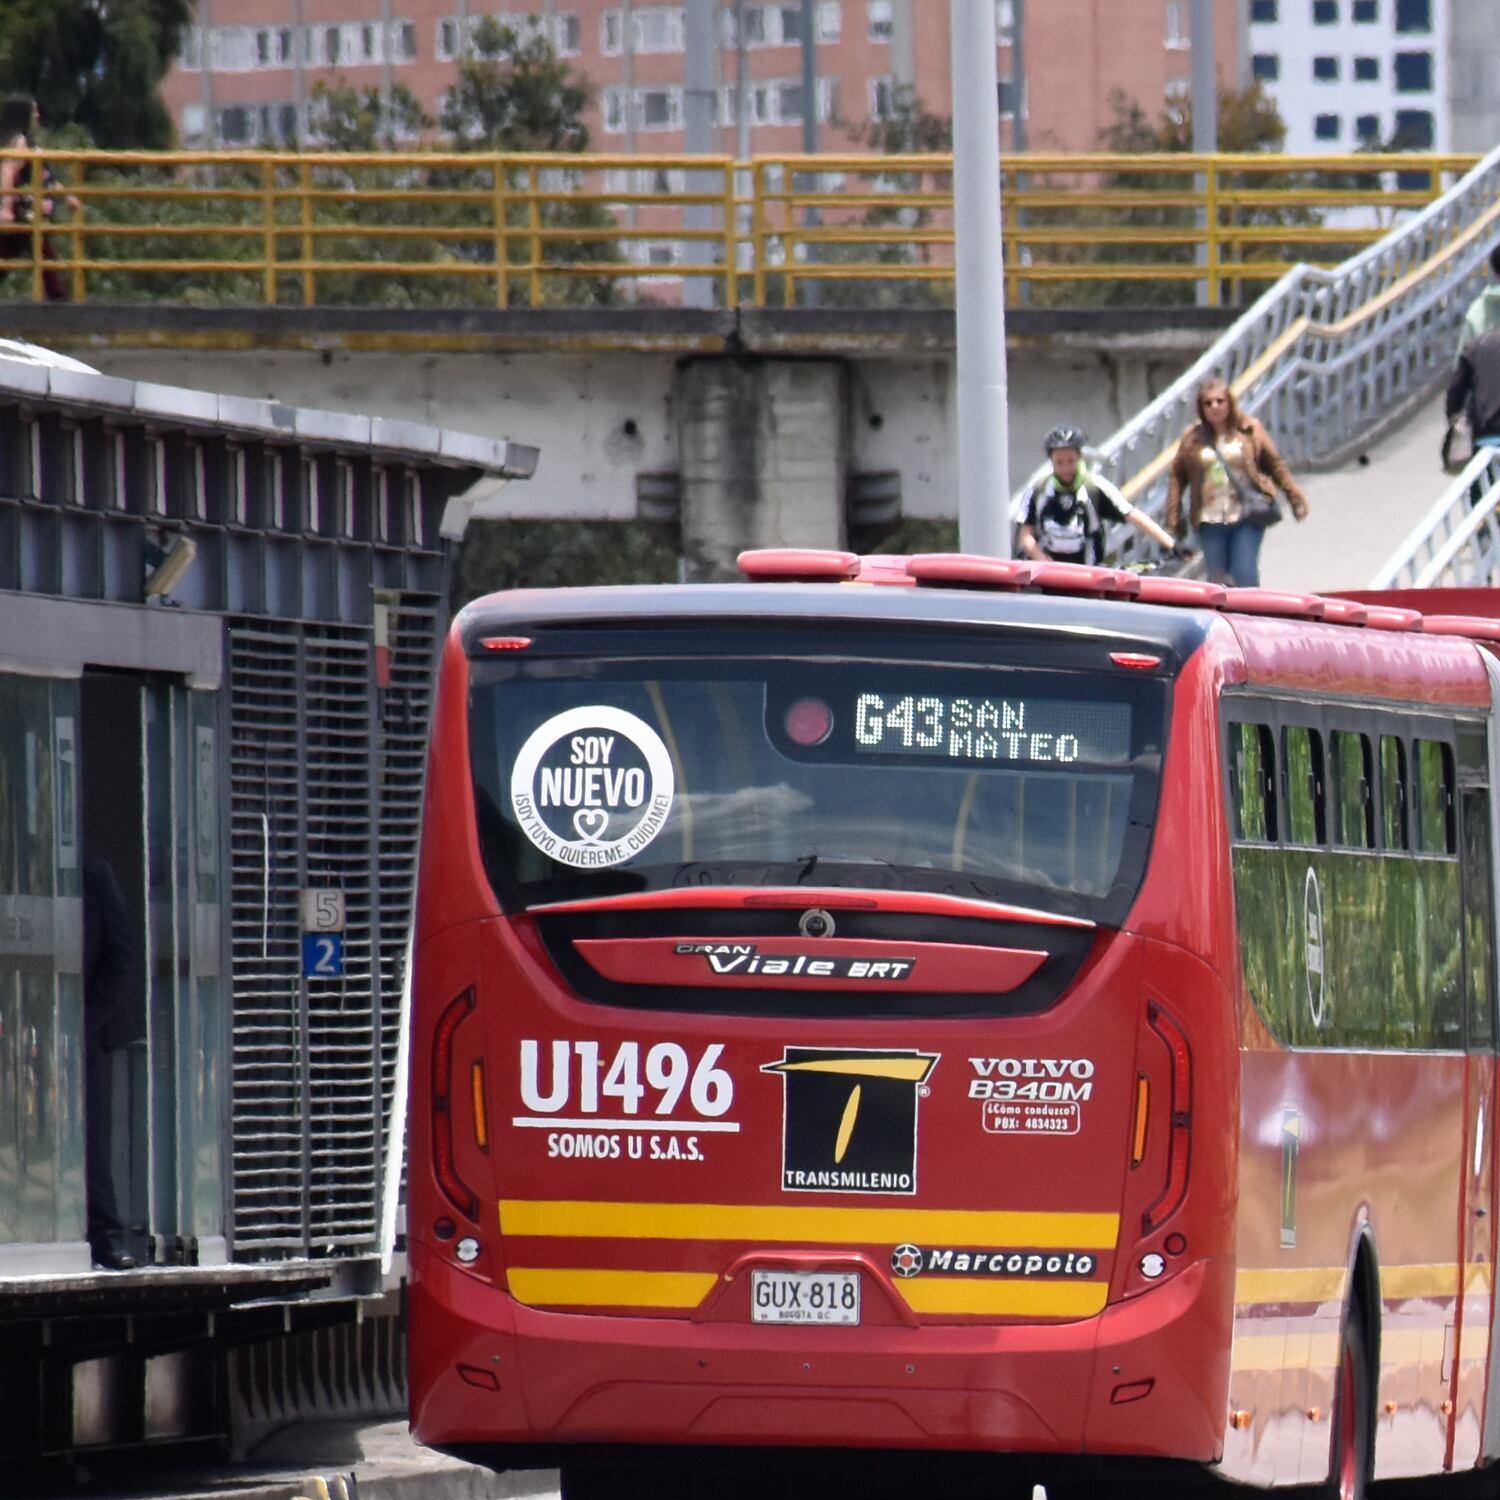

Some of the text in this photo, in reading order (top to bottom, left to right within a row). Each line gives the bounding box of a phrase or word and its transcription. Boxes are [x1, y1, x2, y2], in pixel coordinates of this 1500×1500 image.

[856, 694, 1024, 746] G43 SAN
[570, 736, 615, 765] SOY
[950, 729, 1078, 762] MATEO
[540, 767, 645, 807] NUEVO
[317, 893, 338, 928] 5
[315, 939, 336, 972] 2
[708, 955, 909, 979] Viale BRT
[520, 1039, 734, 1117] U1496
[967, 1057, 1095, 1079] VOLVO
[967, 1079, 1093, 1101] B340M
[547, 1132, 704, 1161] SOMOS U S.A.S.
[785, 1170, 910, 1189] TRANSMILENIO
[928, 1250, 1093, 1275] Marcopolo
